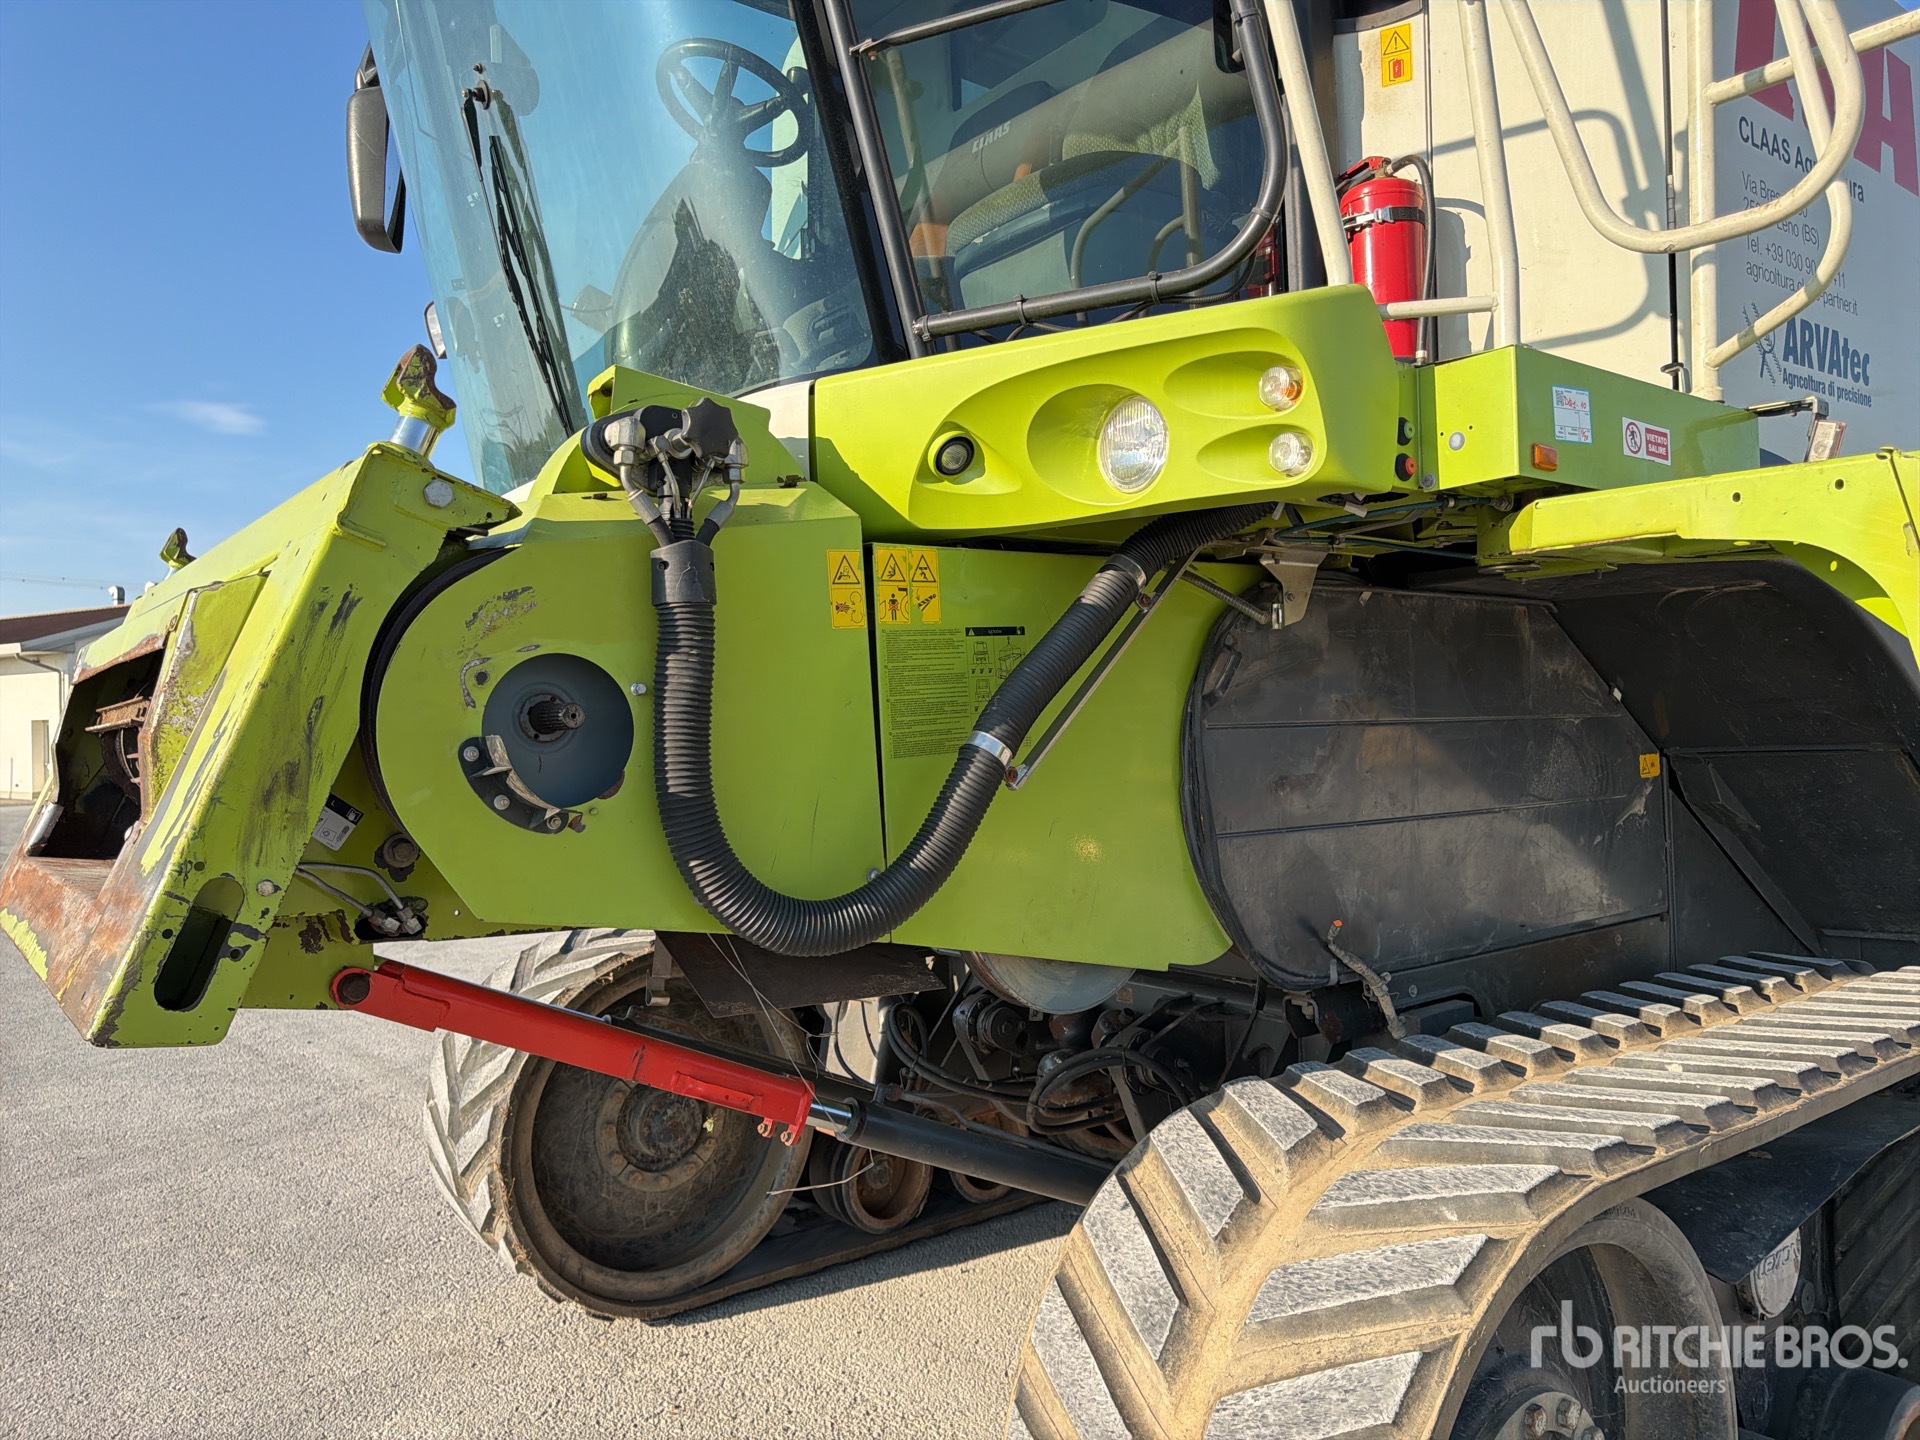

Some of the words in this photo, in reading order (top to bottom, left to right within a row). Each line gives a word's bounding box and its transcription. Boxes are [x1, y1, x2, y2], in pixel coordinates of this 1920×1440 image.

[1738, 116, 1791, 165] CLAAS
[1742, 171, 1758, 196] Via
[1802, 223, 1820, 250] (BS)
[1765, 242, 1784, 264] +39
[1786, 249, 1803, 271] 030
[1783, 316, 1870, 386] ARVAtec
[1783, 367, 1826, 395] Agricoltura
[1828, 380, 1835, 397] di
[1837, 386, 1872, 408] precisione
[1646, 433, 1668, 446] VIETATO
[1648, 443, 1667, 456] SALIRE
